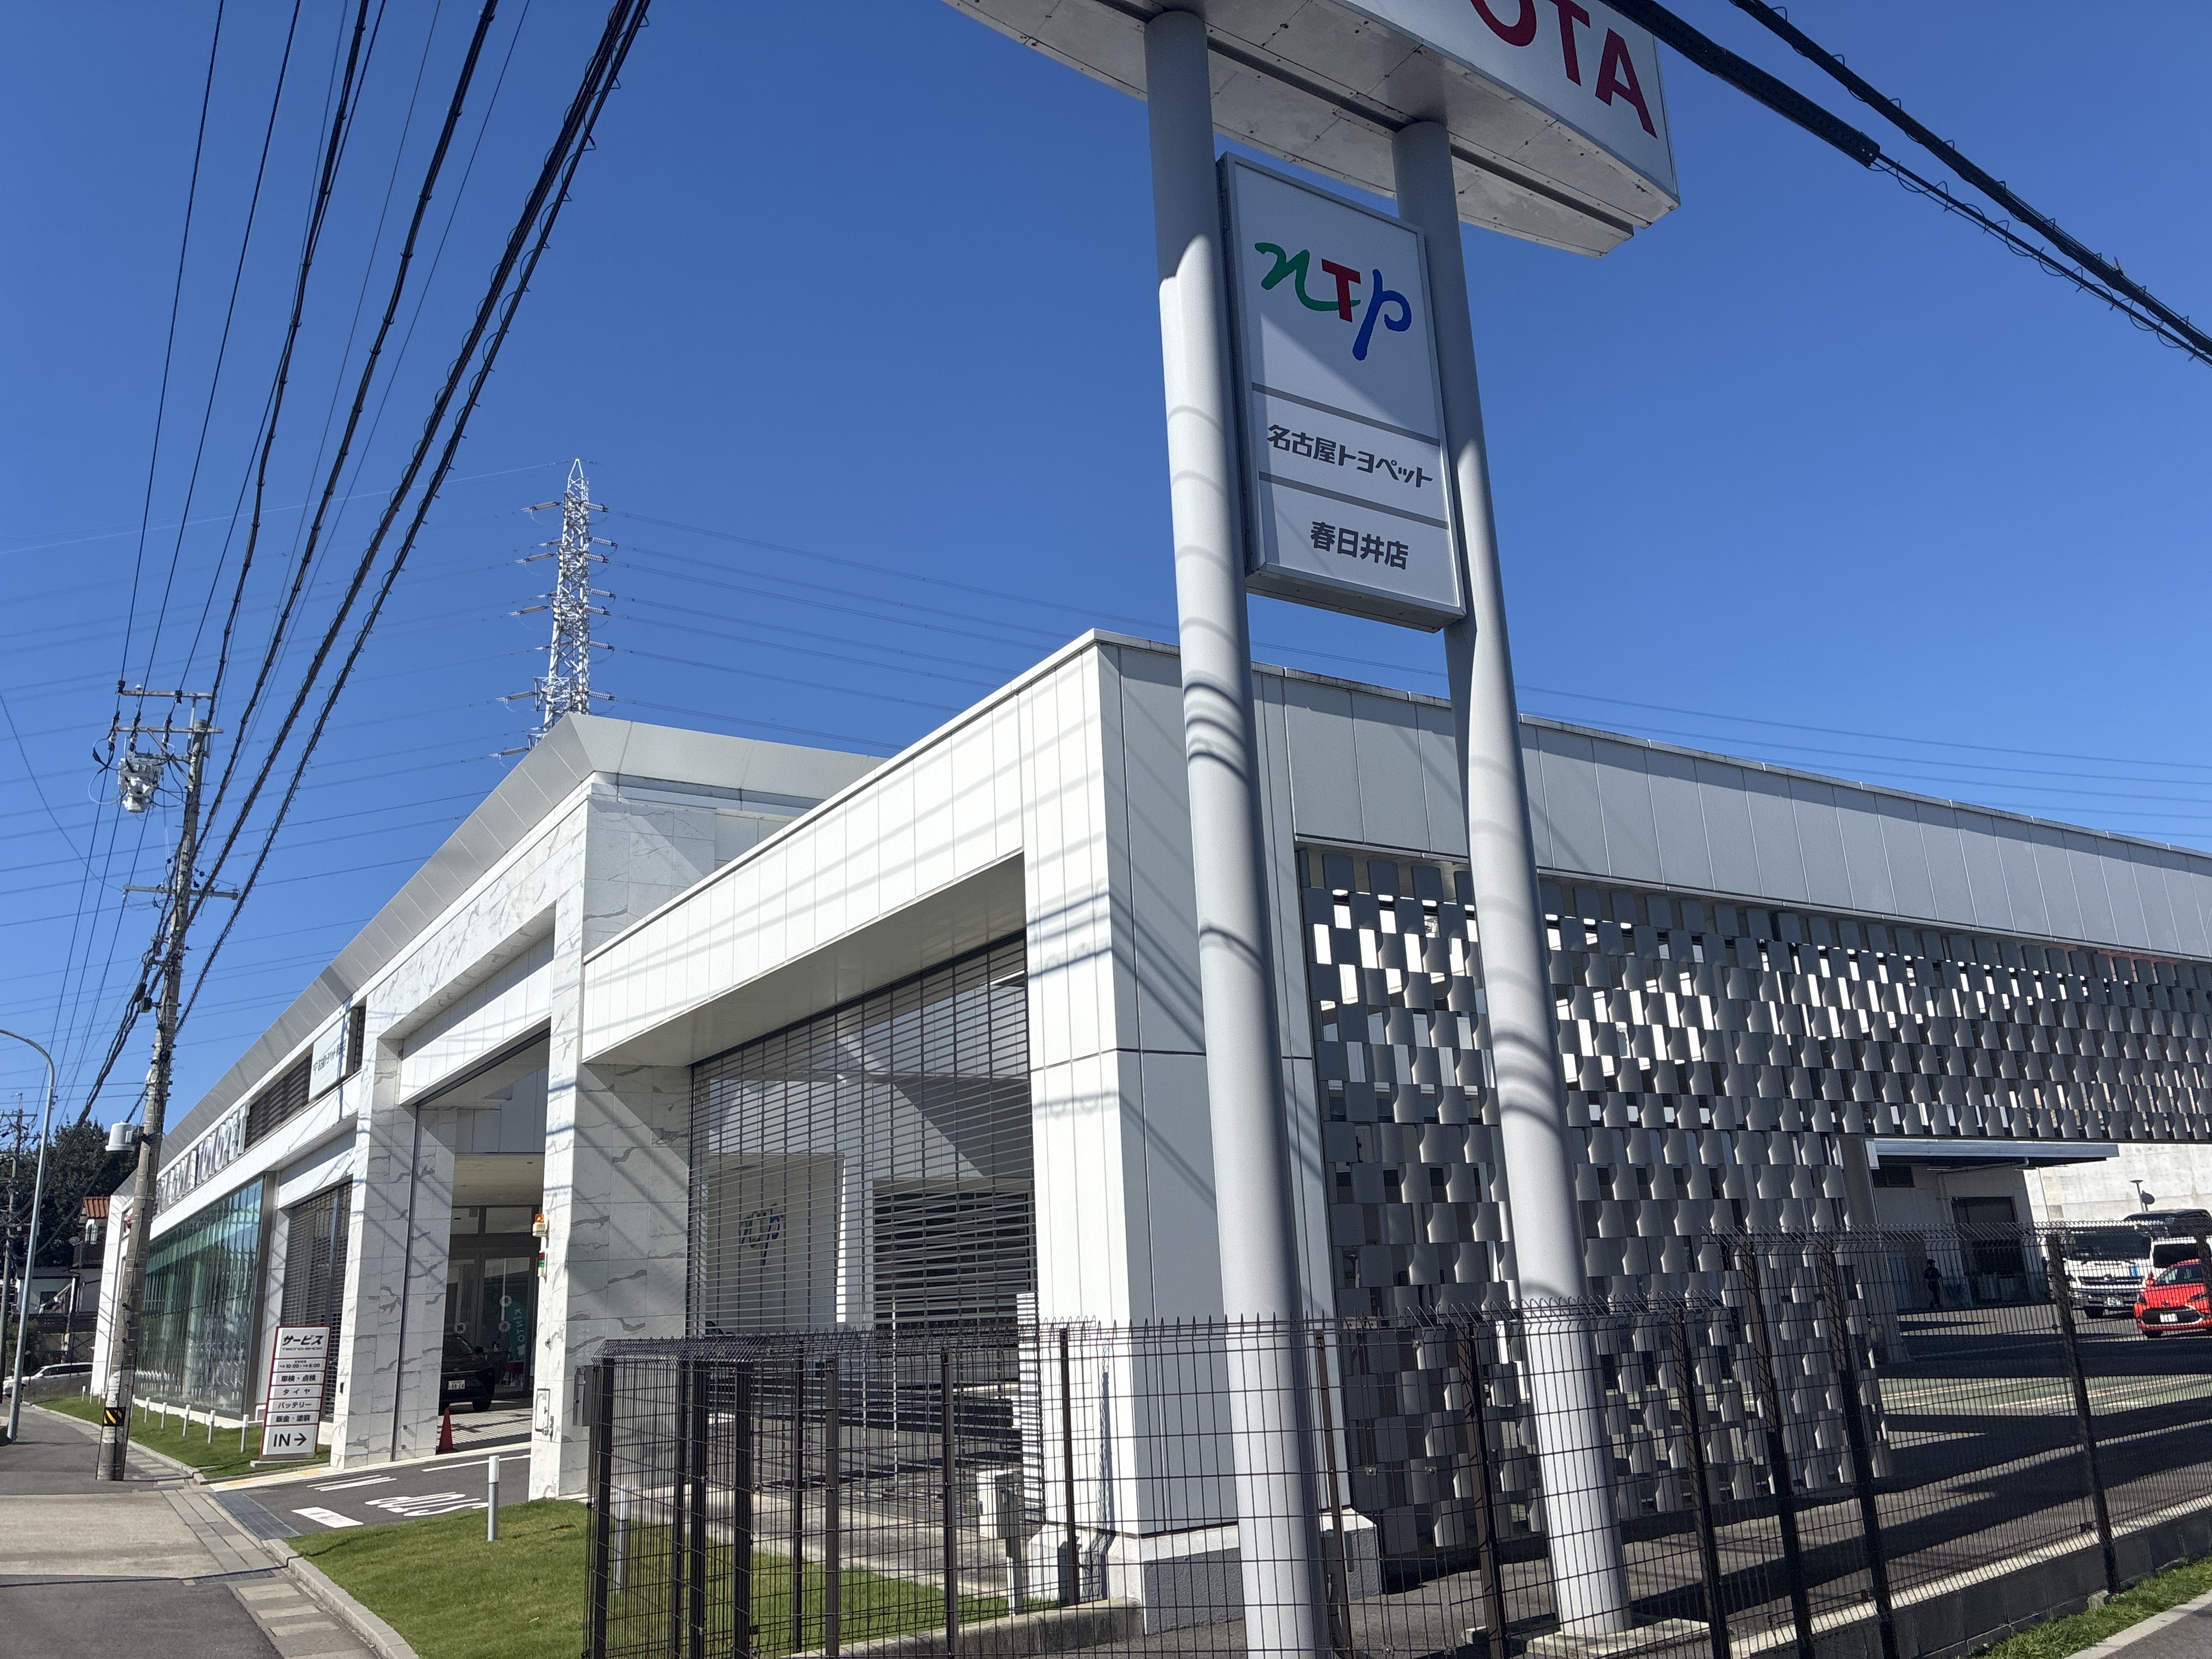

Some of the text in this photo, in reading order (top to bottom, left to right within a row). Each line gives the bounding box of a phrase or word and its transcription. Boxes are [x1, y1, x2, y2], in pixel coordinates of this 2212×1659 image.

[1267, 424, 1433, 488] 名古屋トヨペット
[1310, 521, 1409, 571] 春日井店
[282, 1334, 324, 1346] サービス
[273, 1432, 291, 1447] IN
